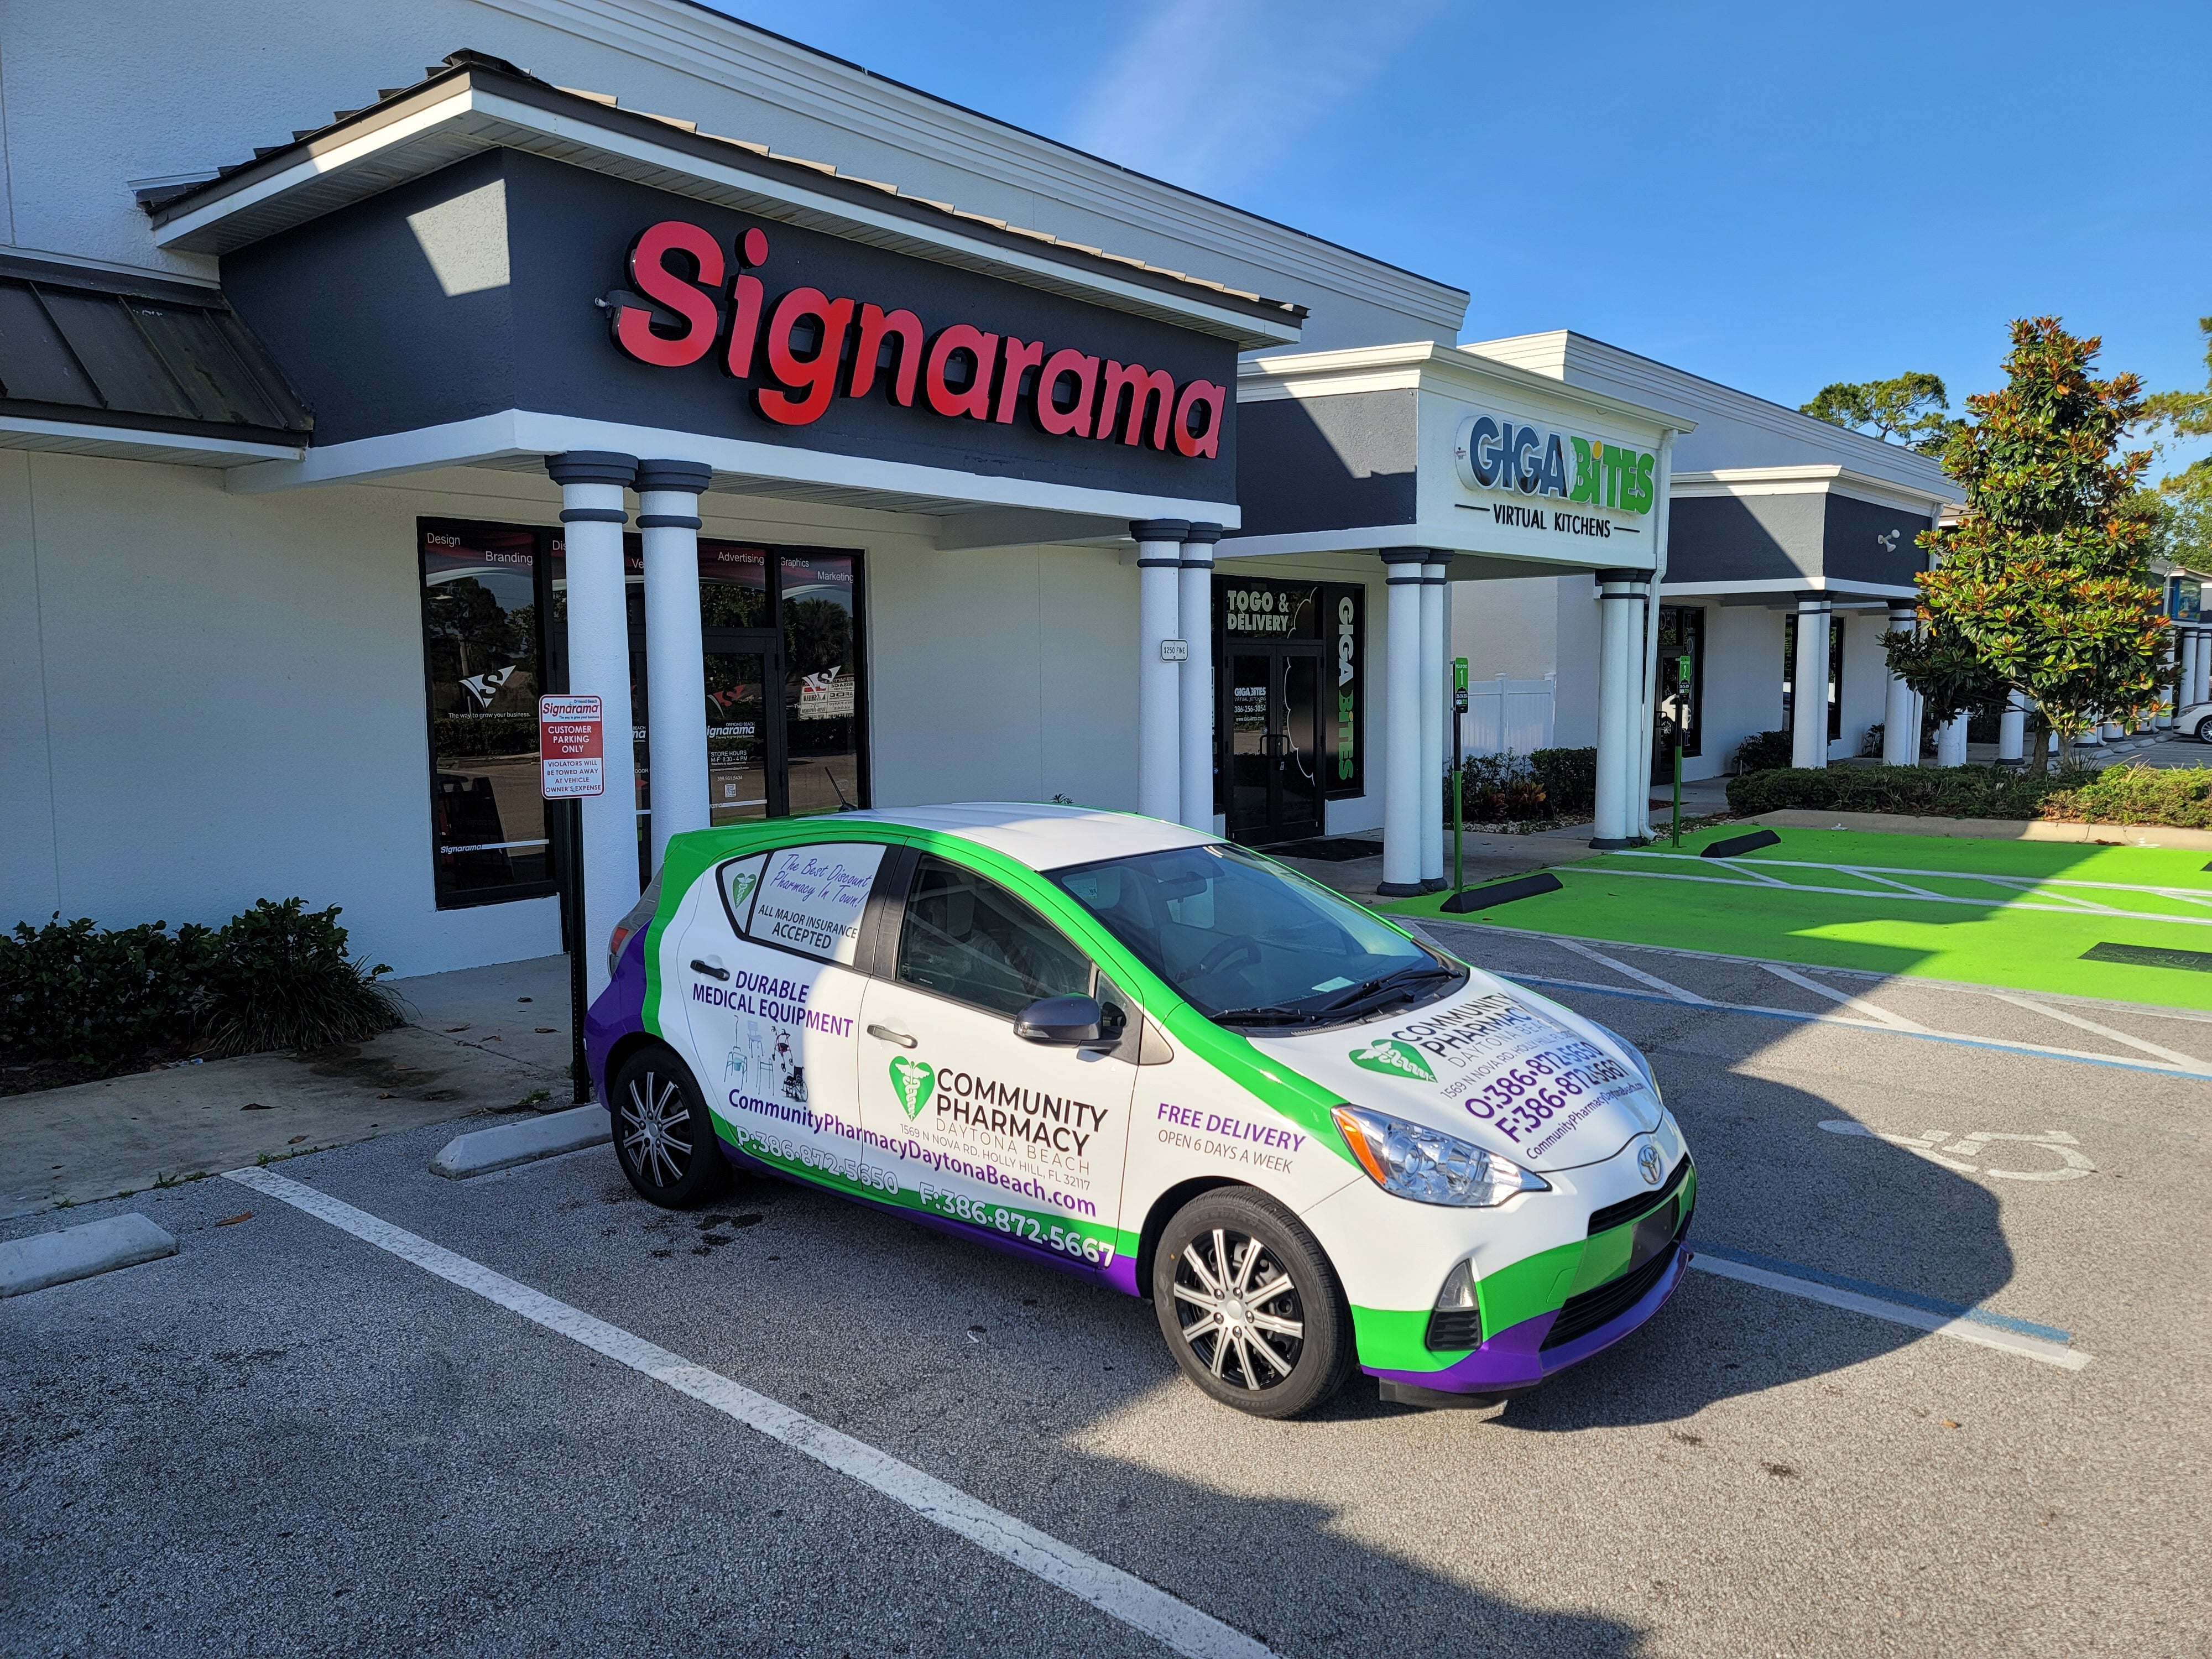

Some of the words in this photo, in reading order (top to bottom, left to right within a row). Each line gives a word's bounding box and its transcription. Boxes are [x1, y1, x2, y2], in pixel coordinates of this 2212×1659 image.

[612, 220, 1227, 460] Signarama
[1493, 503, 1547, 530] VIRTUAL
[1554, 512, 1611, 538] KITCHENS
[427, 533, 461, 546] Design
[485, 551, 533, 566] Branding
[718, 551, 764, 566] Advertising
[780, 556, 810, 568] Graphics
[817, 570, 854, 583] Marketing
[1228, 590, 1274, 612] TOGO
[1279, 593, 1289, 613] &
[1228, 613, 1289, 631] DELIVERY
[1460, 669, 1463, 686] 1
[1683, 665, 1687, 678] 2
[543, 703, 598, 717] Signarama
[1234, 705, 1266, 713] 386-256-3054
[548, 726, 592, 734] CUSTOMER
[553, 735, 590, 744] PARKING
[707, 725, 755, 738] ignarama
[561, 745, 584, 753] ONLY
[440, 844, 482, 854] Signarama
[780, 854, 800, 872] The
[800, 858, 829, 878] Best
[827, 864, 873, 888] Discount
[770, 870, 817, 902] Pharmacy
[817, 881, 832, 900] In
[832, 885, 869, 908] Town!
[758, 904, 773, 918] ALL
[774, 907, 806, 926] MAJOR
[805, 916, 858, 939] INSURANCE
[771, 921, 832, 950] ACCEPTED
[735, 969, 810, 1004] DURABLE
[692, 983, 755, 1015] MEDICAL
[759, 998, 854, 1038] EQUIPMENT
[1391, 992, 1520, 1042] COMMUNITY
[1448, 1030, 1518, 1068] DAYTONA
[1439, 1081, 1467, 1100] 1569
[1465, 1074, 1478, 1086] N
[1472, 1060, 1504, 1081] NOVA
[1514, 1041, 1538, 1055] HOLLY
[937, 1068, 1109, 1133] COMMUNITY
[937, 1093, 1091, 1157] PHARMACY
[1157, 1103, 1203, 1129] FREE
[1206, 1114, 1306, 1152] DELIVERY
[728, 1088, 1096, 1218] CommunityPharmacyDaytonaBeach.com
[900, 1123, 920, 1138] 1569
[923, 1130, 930, 1142] N
[932, 1134, 961, 1151] NOVA
[963, 1143, 980, 1157] RD.
[983, 1150, 1016, 1168] HOLLY
[1019, 1161, 1046, 1180] HILL,
[1048, 1170, 1061, 1183] FL
[1063, 1174, 1091, 1191] 32117
[936, 1118, 1018, 1155] DAYTONA
[1027, 1145, 1090, 1176] BEACH
[1159, 1129, 1192, 1149] OPEN
[1194, 1139, 1202, 1151] 6
[1204, 1140, 1238, 1160] DAYS
[1239, 1149, 1249, 1163] A
[1253, 1151, 1293, 1174] WEEK
